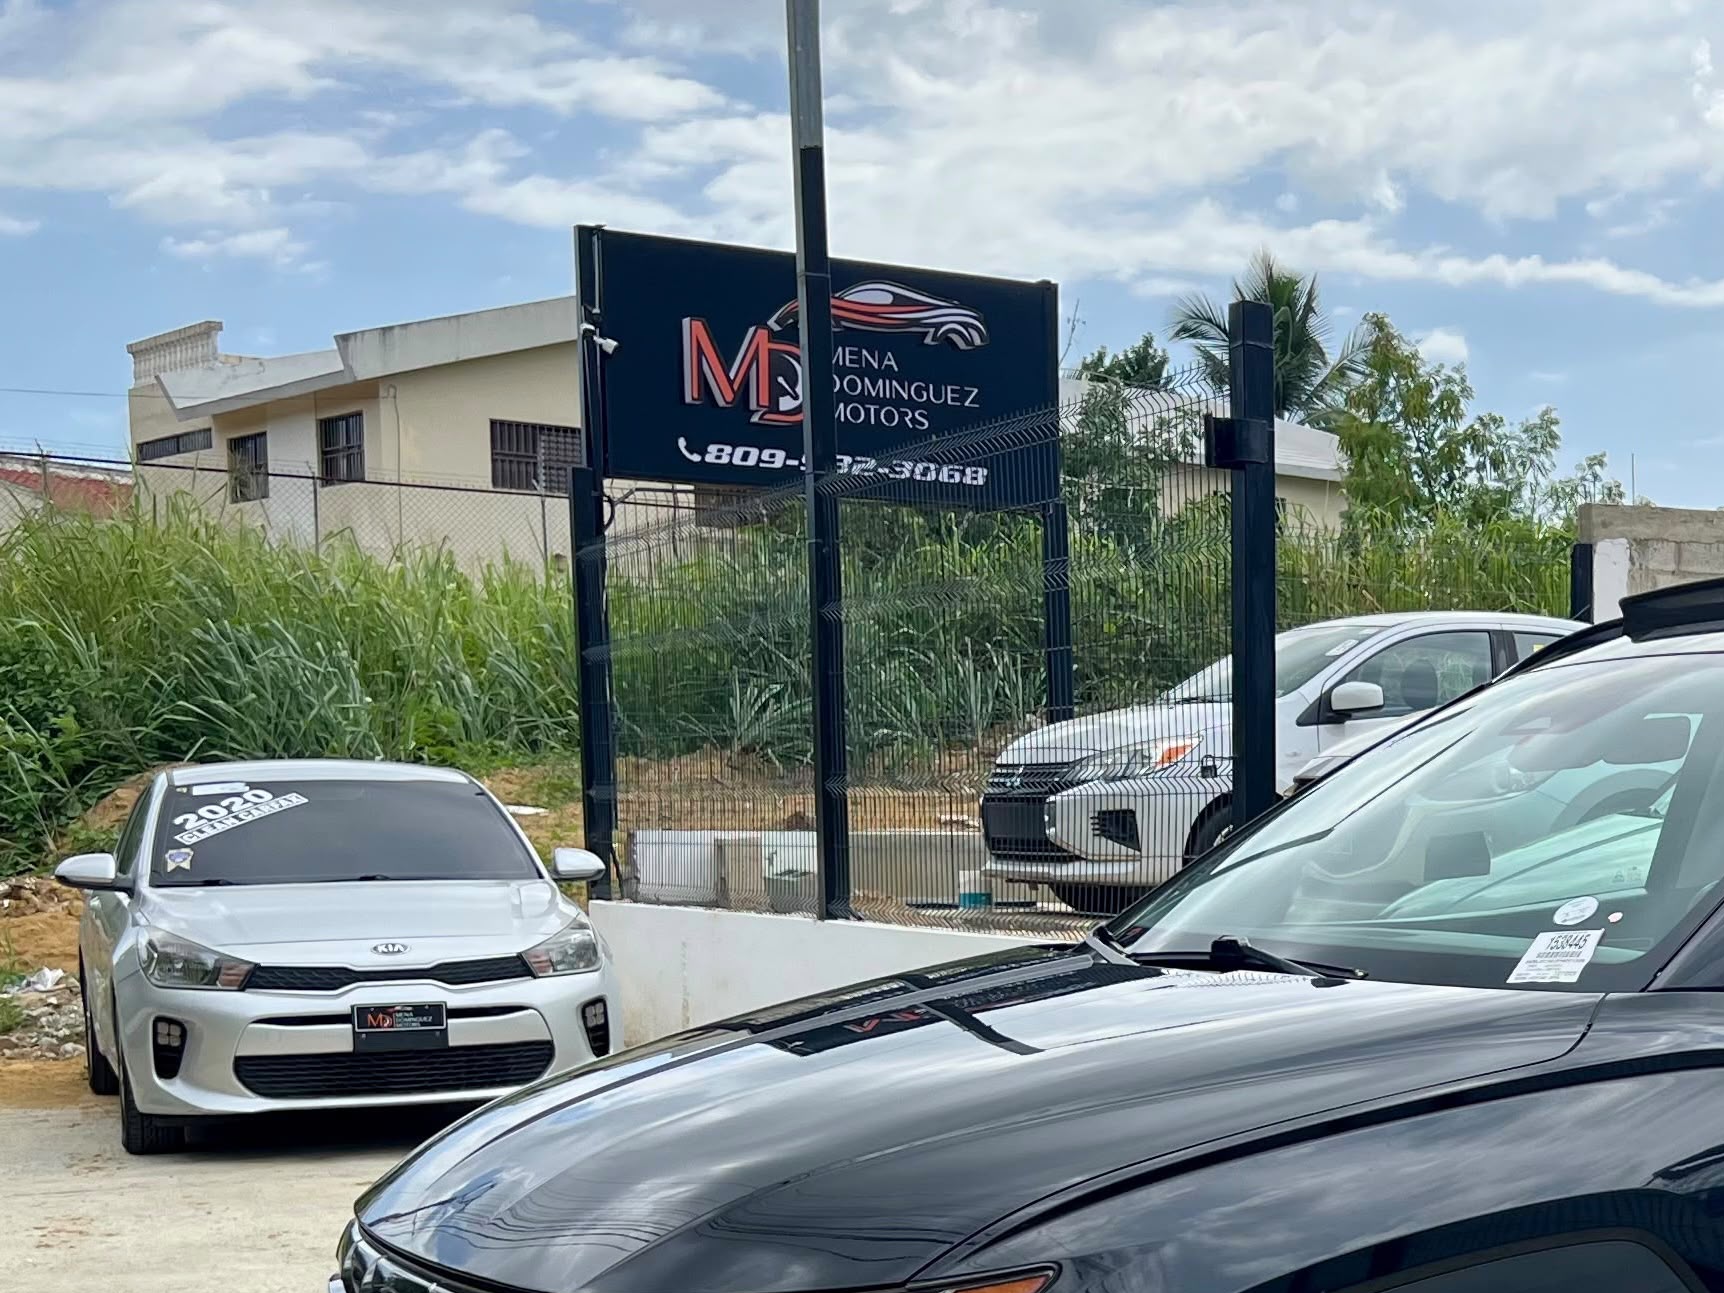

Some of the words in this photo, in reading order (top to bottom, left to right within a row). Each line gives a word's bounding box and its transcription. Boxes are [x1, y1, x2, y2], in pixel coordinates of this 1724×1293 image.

[704, 443, 988, 485] 809-32-3068
[173, 789, 274, 830] 2020
[183, 816, 236, 842] CLEAN
[238, 794, 304, 821] CARFAX
[377, 943, 405, 953] KIA
